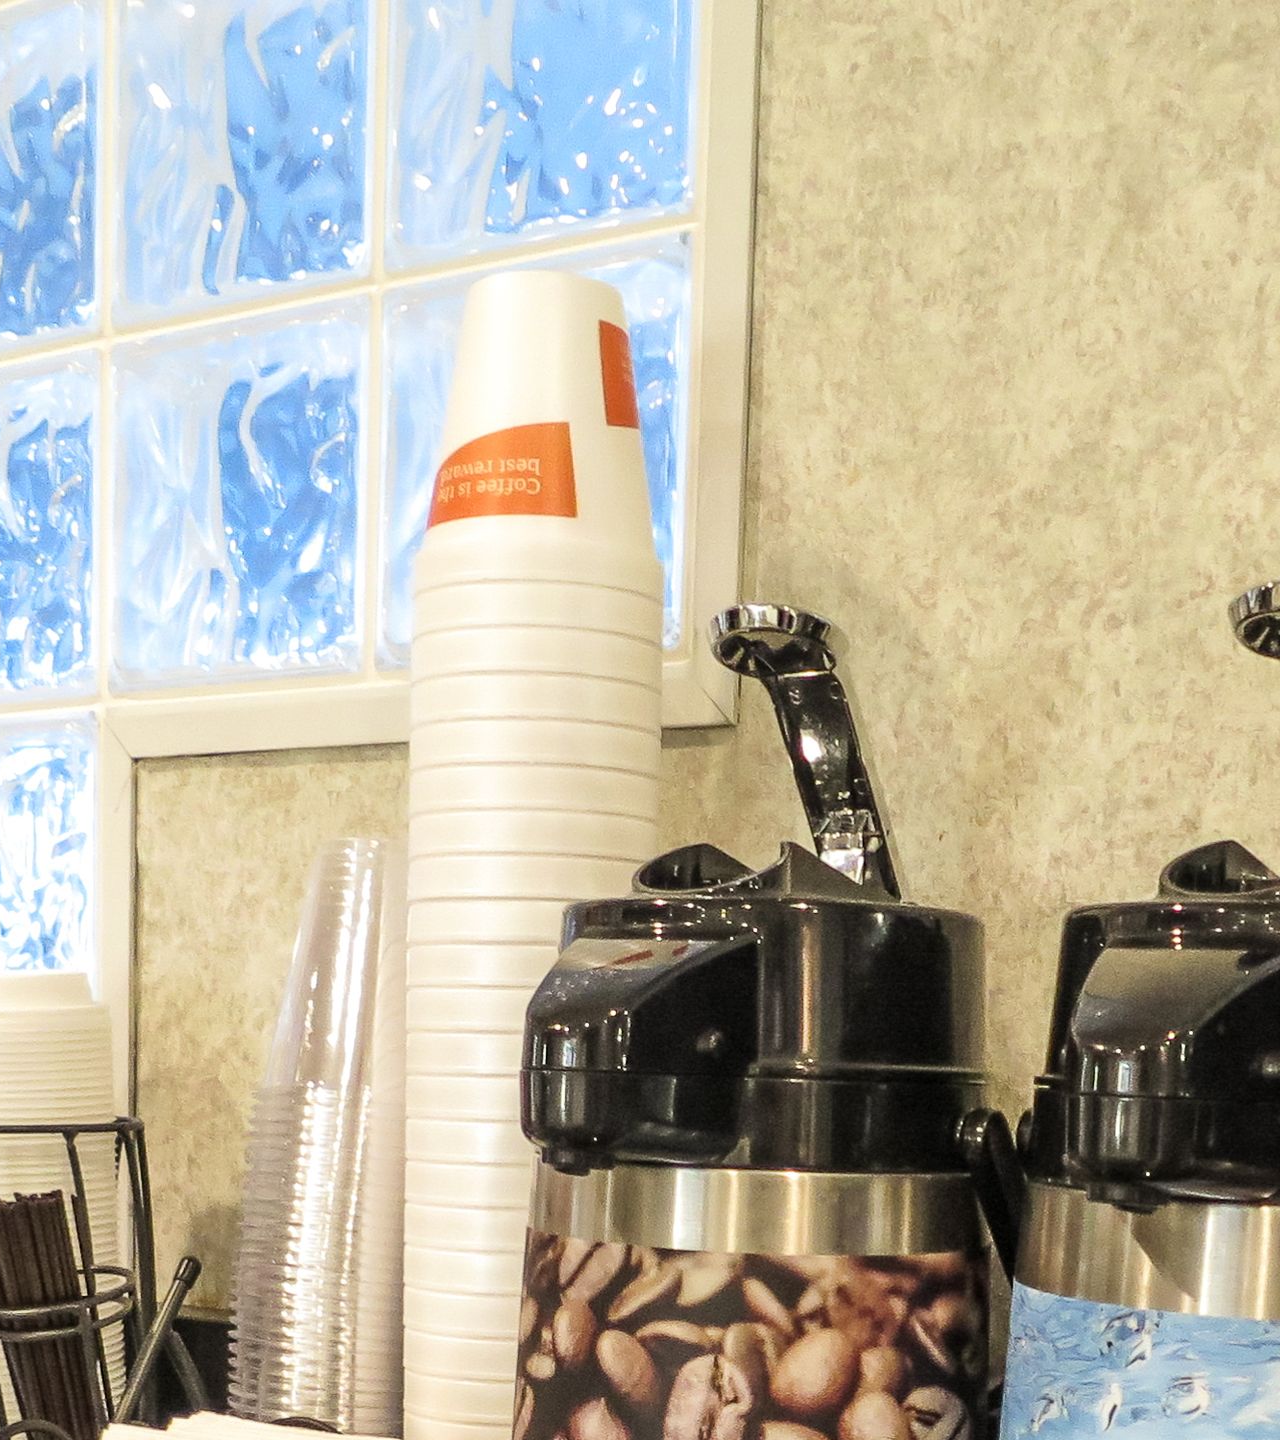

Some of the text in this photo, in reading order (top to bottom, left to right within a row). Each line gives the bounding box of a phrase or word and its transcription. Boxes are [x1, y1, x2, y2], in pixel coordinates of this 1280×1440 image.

[499, 457, 542, 476] best
[459, 480, 472, 498] is
[476, 477, 541, 496] Coffee
